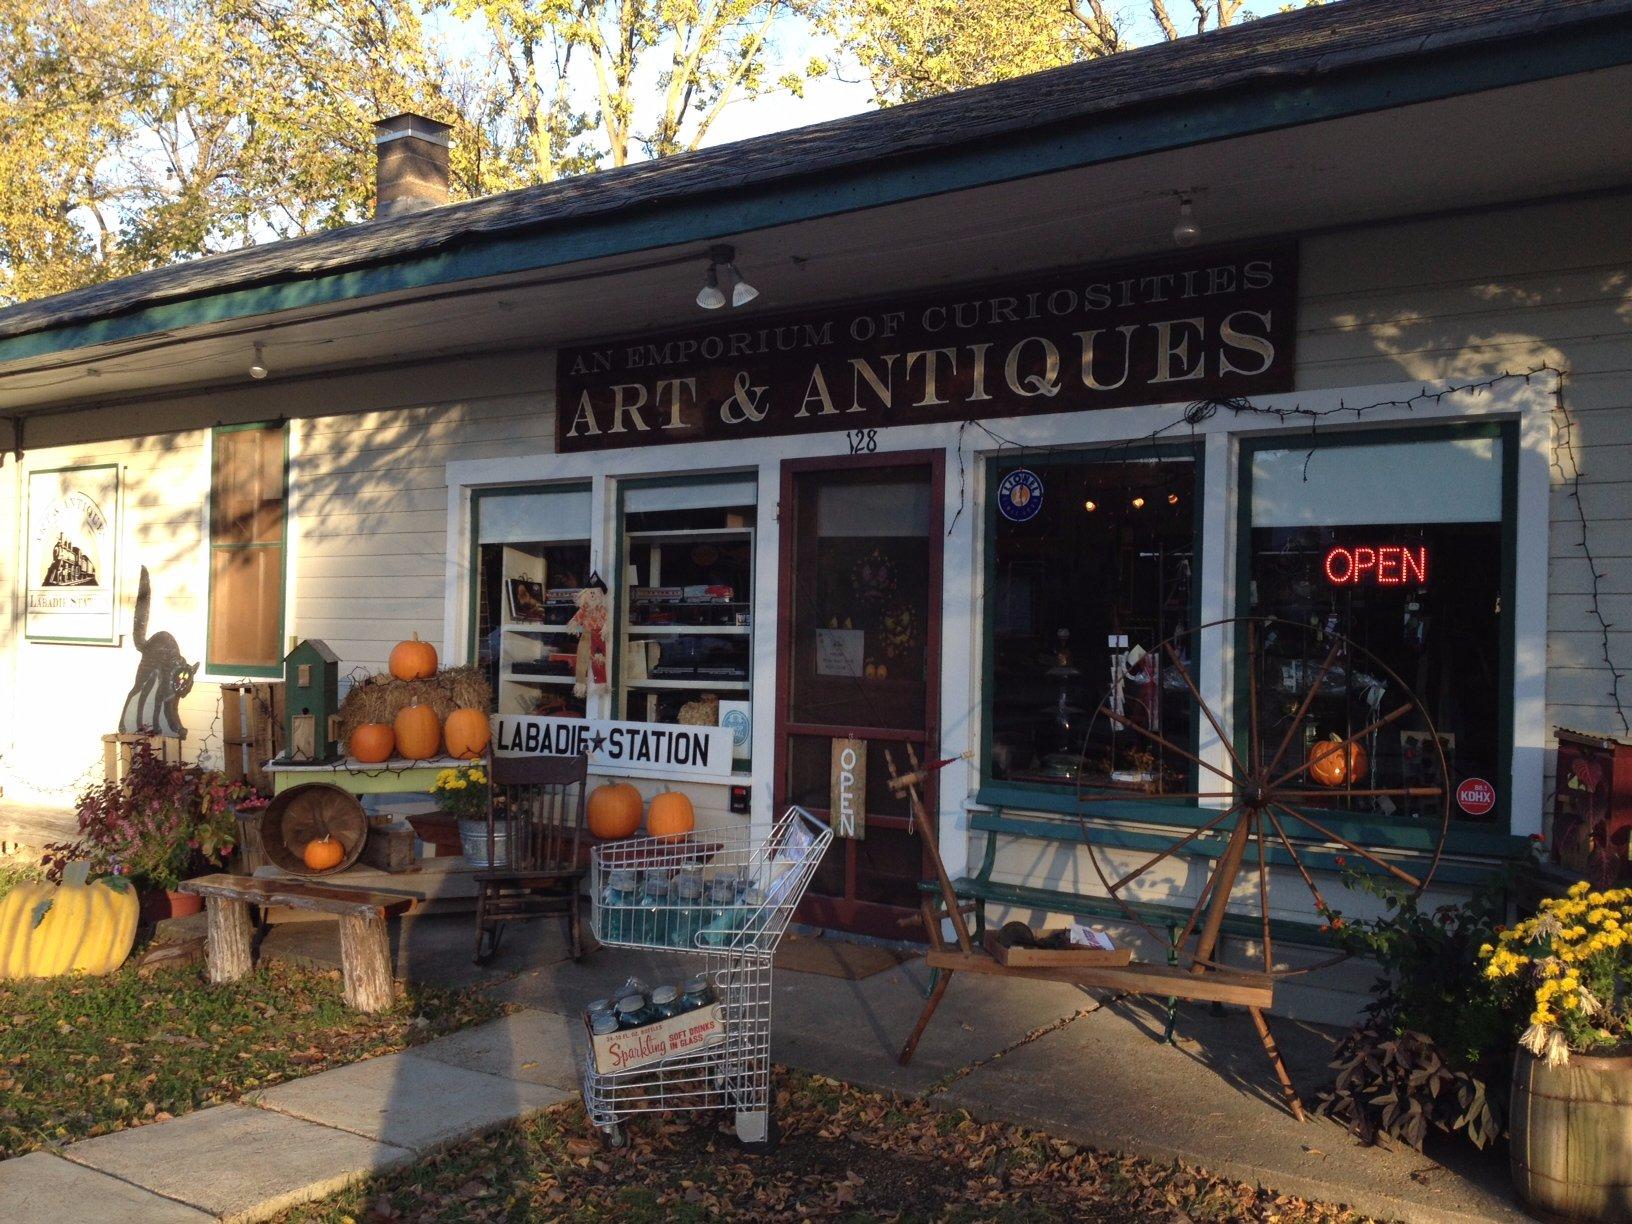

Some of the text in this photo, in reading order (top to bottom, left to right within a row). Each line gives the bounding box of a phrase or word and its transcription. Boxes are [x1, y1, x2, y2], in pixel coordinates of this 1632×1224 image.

[570, 260, 1274, 375] AN EMPORIUM OF CURIOSITIES
[566, 310, 1275, 437] ART & ANTIQUES
[847, 429, 877, 455] 128
[1002, 474, 1040, 493] LIONEL
[1326, 546, 1426, 583] OPEN
[498, 721, 590, 755] LABADIE
[608, 728, 710, 767] STATION
[840, 748, 856, 836] OPEN
[1461, 791, 1490, 802] KDHX
[668, 1021, 715, 1042] SOFT DRINKS
[669, 1034, 704, 1050] IN GLASS
[609, 1034, 667, 1068] Sparkling
